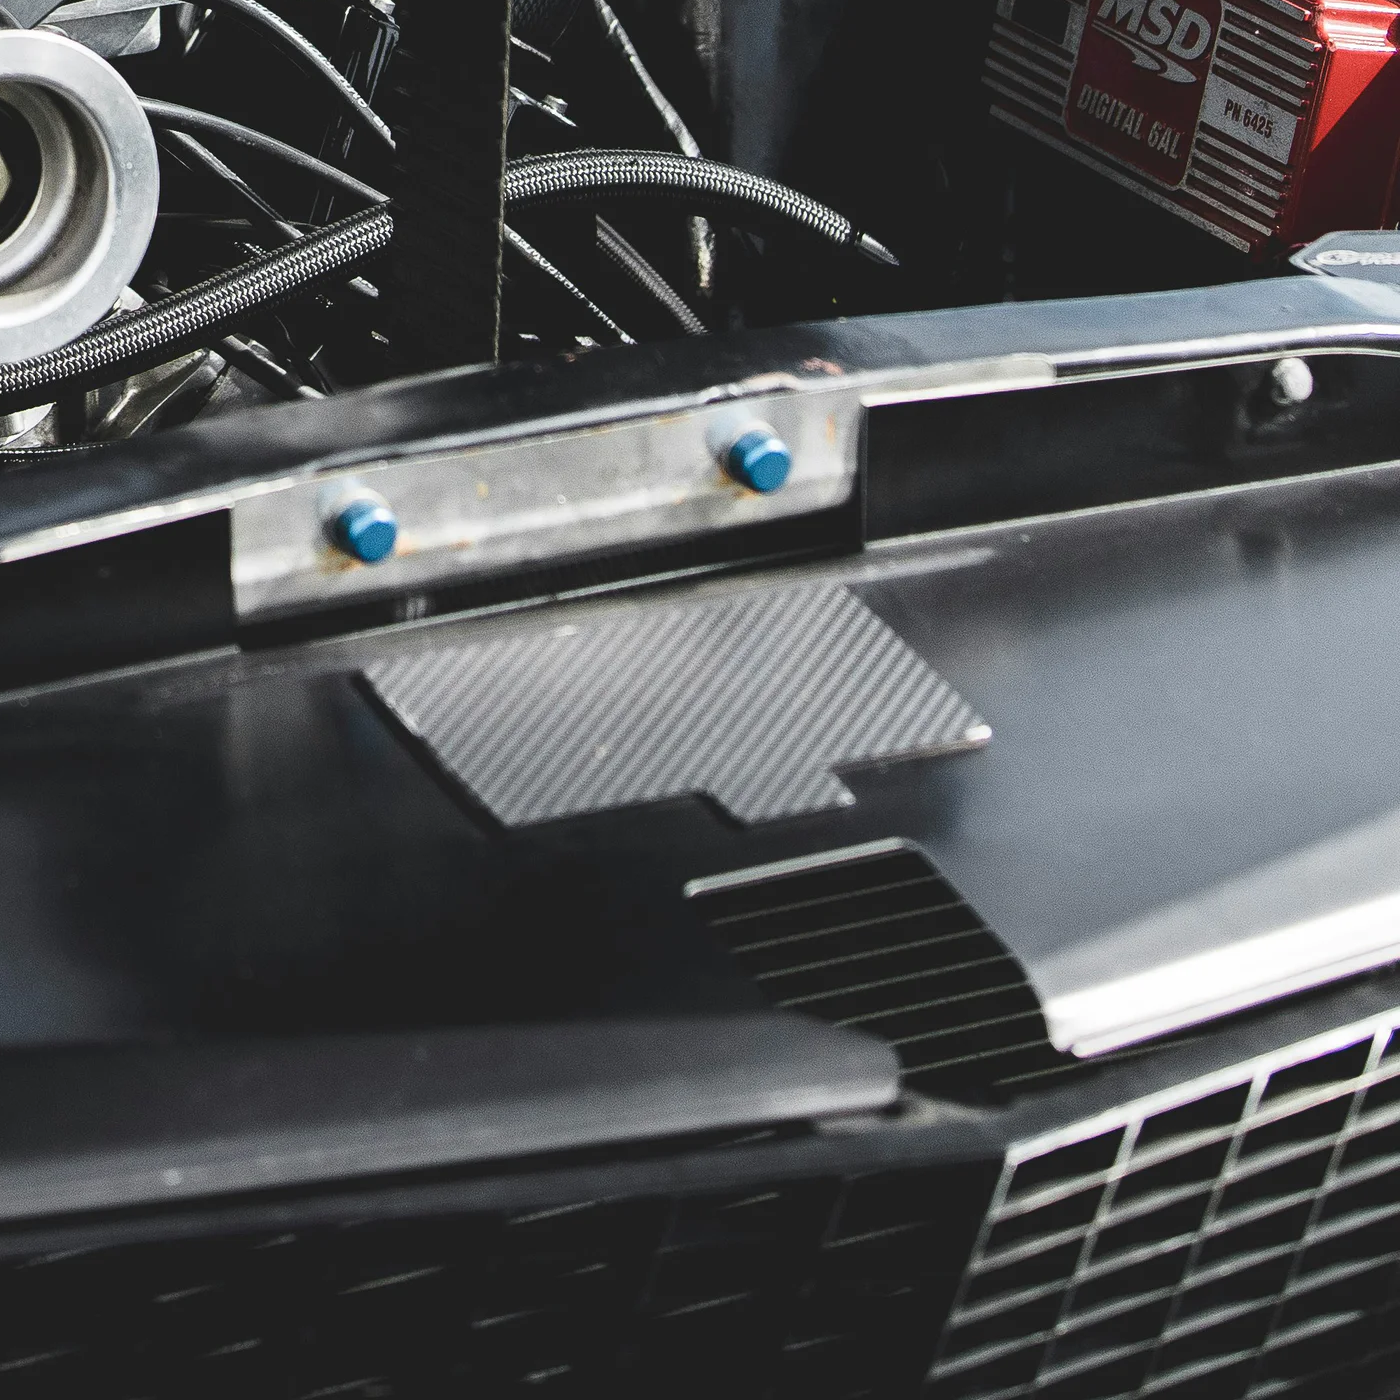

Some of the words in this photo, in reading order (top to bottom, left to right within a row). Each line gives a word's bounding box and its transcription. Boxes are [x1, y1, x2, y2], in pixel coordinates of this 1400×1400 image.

[1077, 83, 1144, 140] DIGITAL
[1147, 120, 1182, 160] 6AL
[1223, 98, 1243, 122] PN
[1242, 108, 1274, 138] 6425
